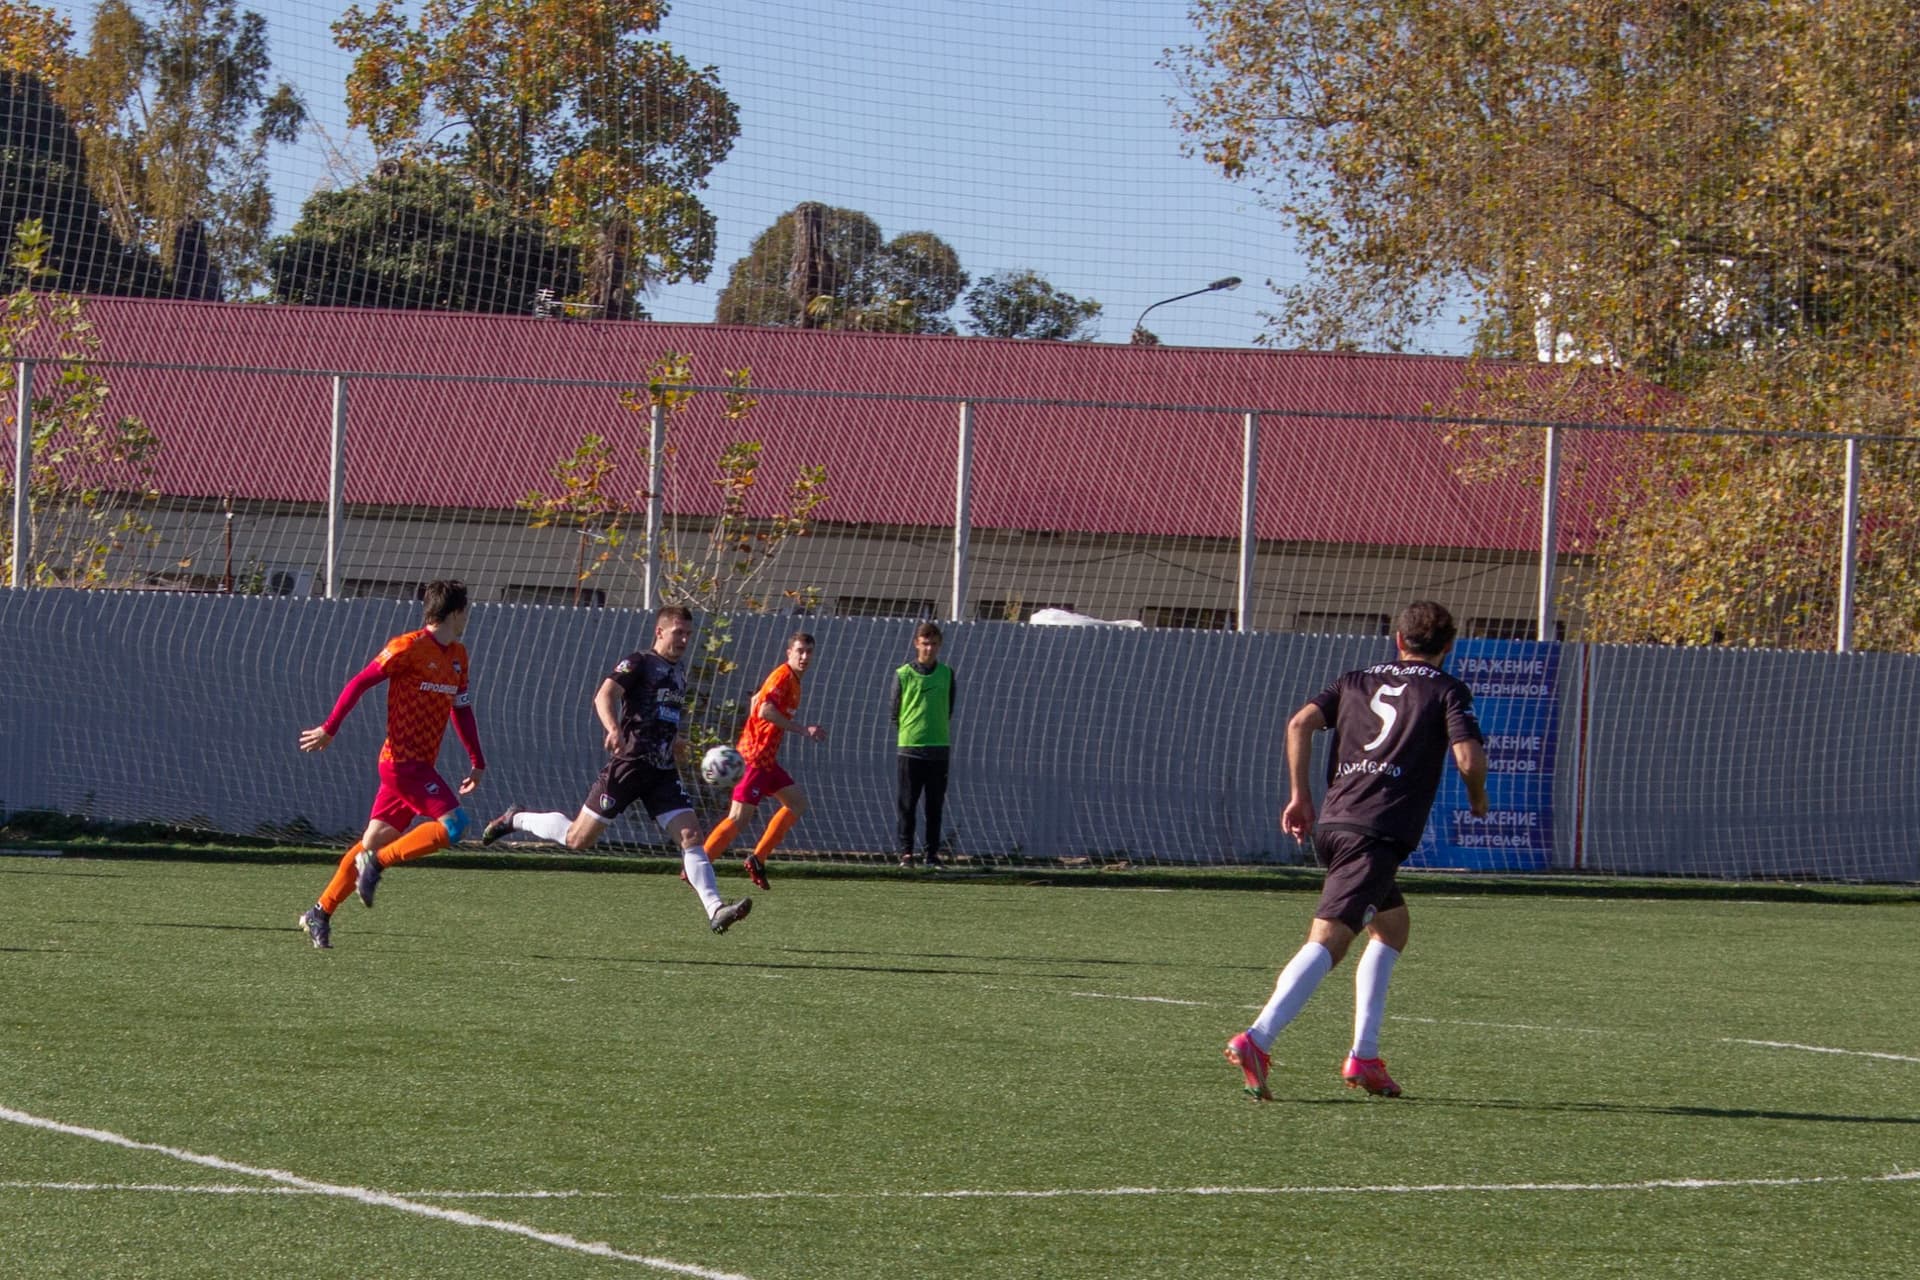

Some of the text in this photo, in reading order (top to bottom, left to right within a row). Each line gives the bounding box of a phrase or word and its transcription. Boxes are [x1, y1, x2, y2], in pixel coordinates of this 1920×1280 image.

[1458, 659, 1543, 674] УВАЖЕНИЕ
[1465, 682, 1549, 697] оперников
[1363, 682, 1408, 752] 5
[1484, 735, 1541, 750] ЖЕНИЕ
[1489, 758, 1537, 773] итров
[1453, 810, 1537, 826] УВАЖЕНИЕ
[1457, 833, 1531, 847] зрителей
